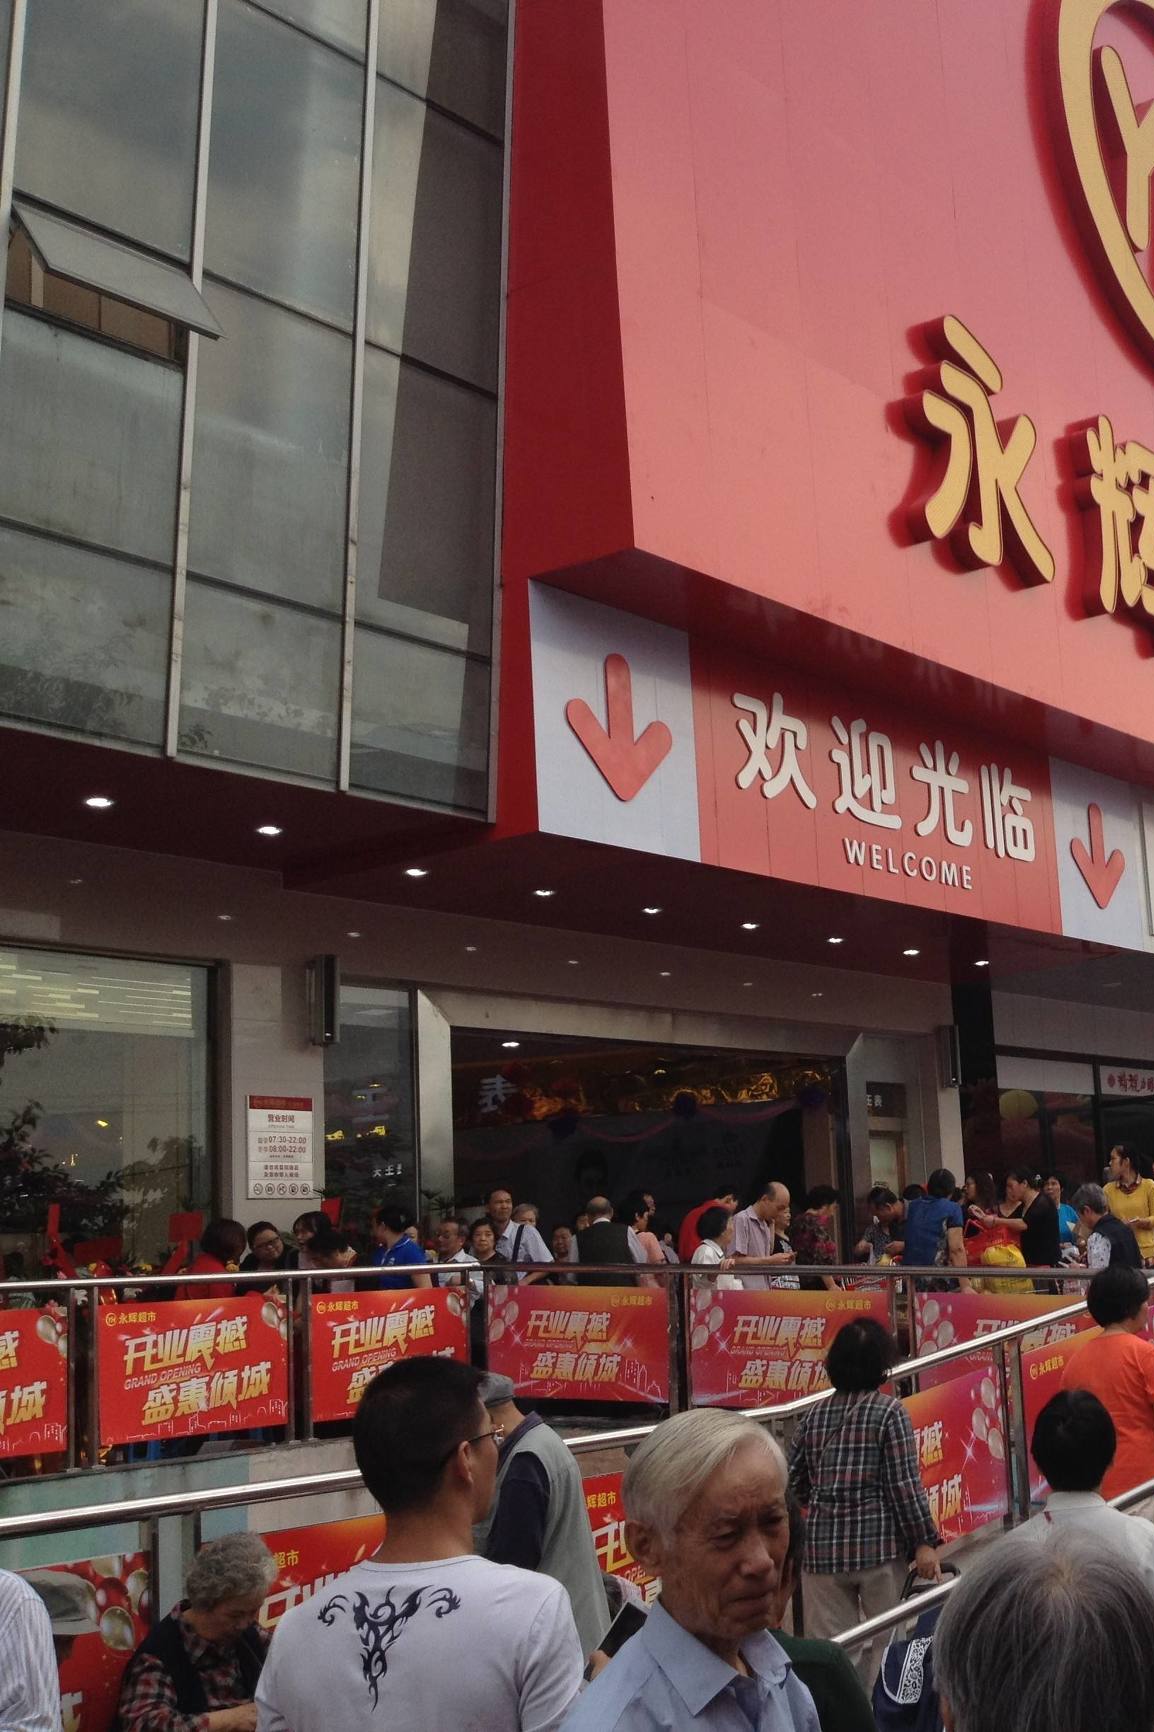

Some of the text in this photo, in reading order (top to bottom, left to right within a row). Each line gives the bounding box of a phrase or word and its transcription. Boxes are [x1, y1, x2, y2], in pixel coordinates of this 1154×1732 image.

[731, 692, 1035, 862] 欢迎光临
[843, 837, 974, 891] WELCOME
[118, 1311, 157, 1324] 永辉超市
[327, 1300, 359, 1312] 永辉超市
[124, 1315, 248, 1376] 开业震撼
[331, 1304, 435, 1359] 开业震撼
[525, 1309, 611, 1351] 开业震撼
[733, 1315, 827, 1360] 开业震撼
[124, 1362, 202, 1391] GRAND OPENING
[331, 1347, 397, 1372] GRAND OPENING
[530, 1351, 622, 1383] 盛惠倾城
[1039, 1355, 1064, 1375] 永辉超市
[142, 1361, 272, 1426] 盛惠倾城
